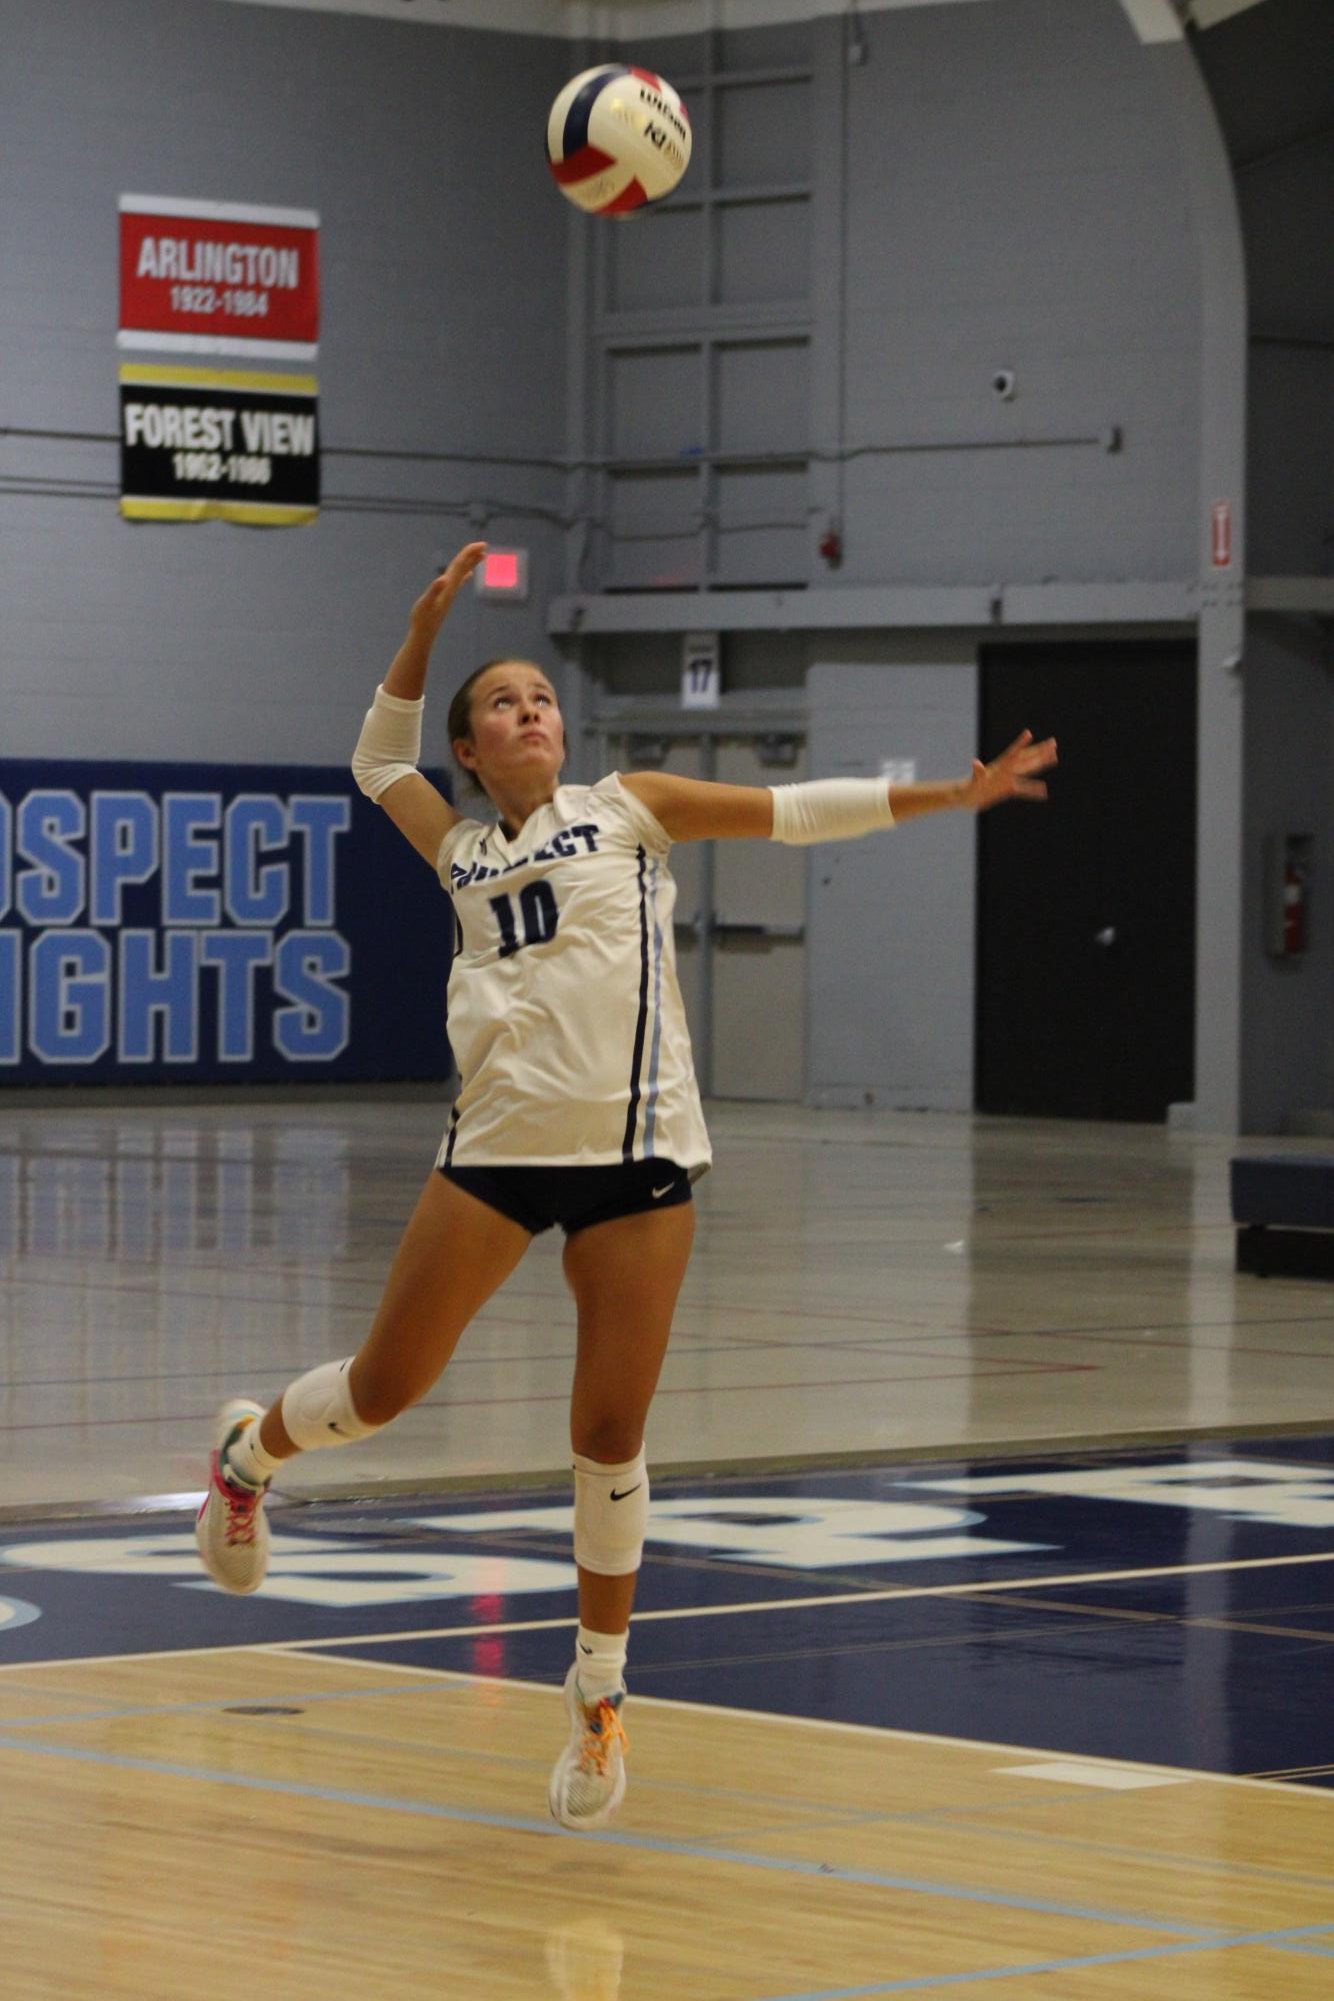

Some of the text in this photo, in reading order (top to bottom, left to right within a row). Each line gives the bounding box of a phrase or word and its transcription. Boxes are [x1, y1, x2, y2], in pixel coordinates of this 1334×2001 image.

[137, 236, 299, 289] ARLINGTON
[124, 403, 316, 456] FOREST VIEW
[689, 657, 713, 695] 17
[0, 789, 352, 927] SPECT
[488, 879, 560, 959] 10
